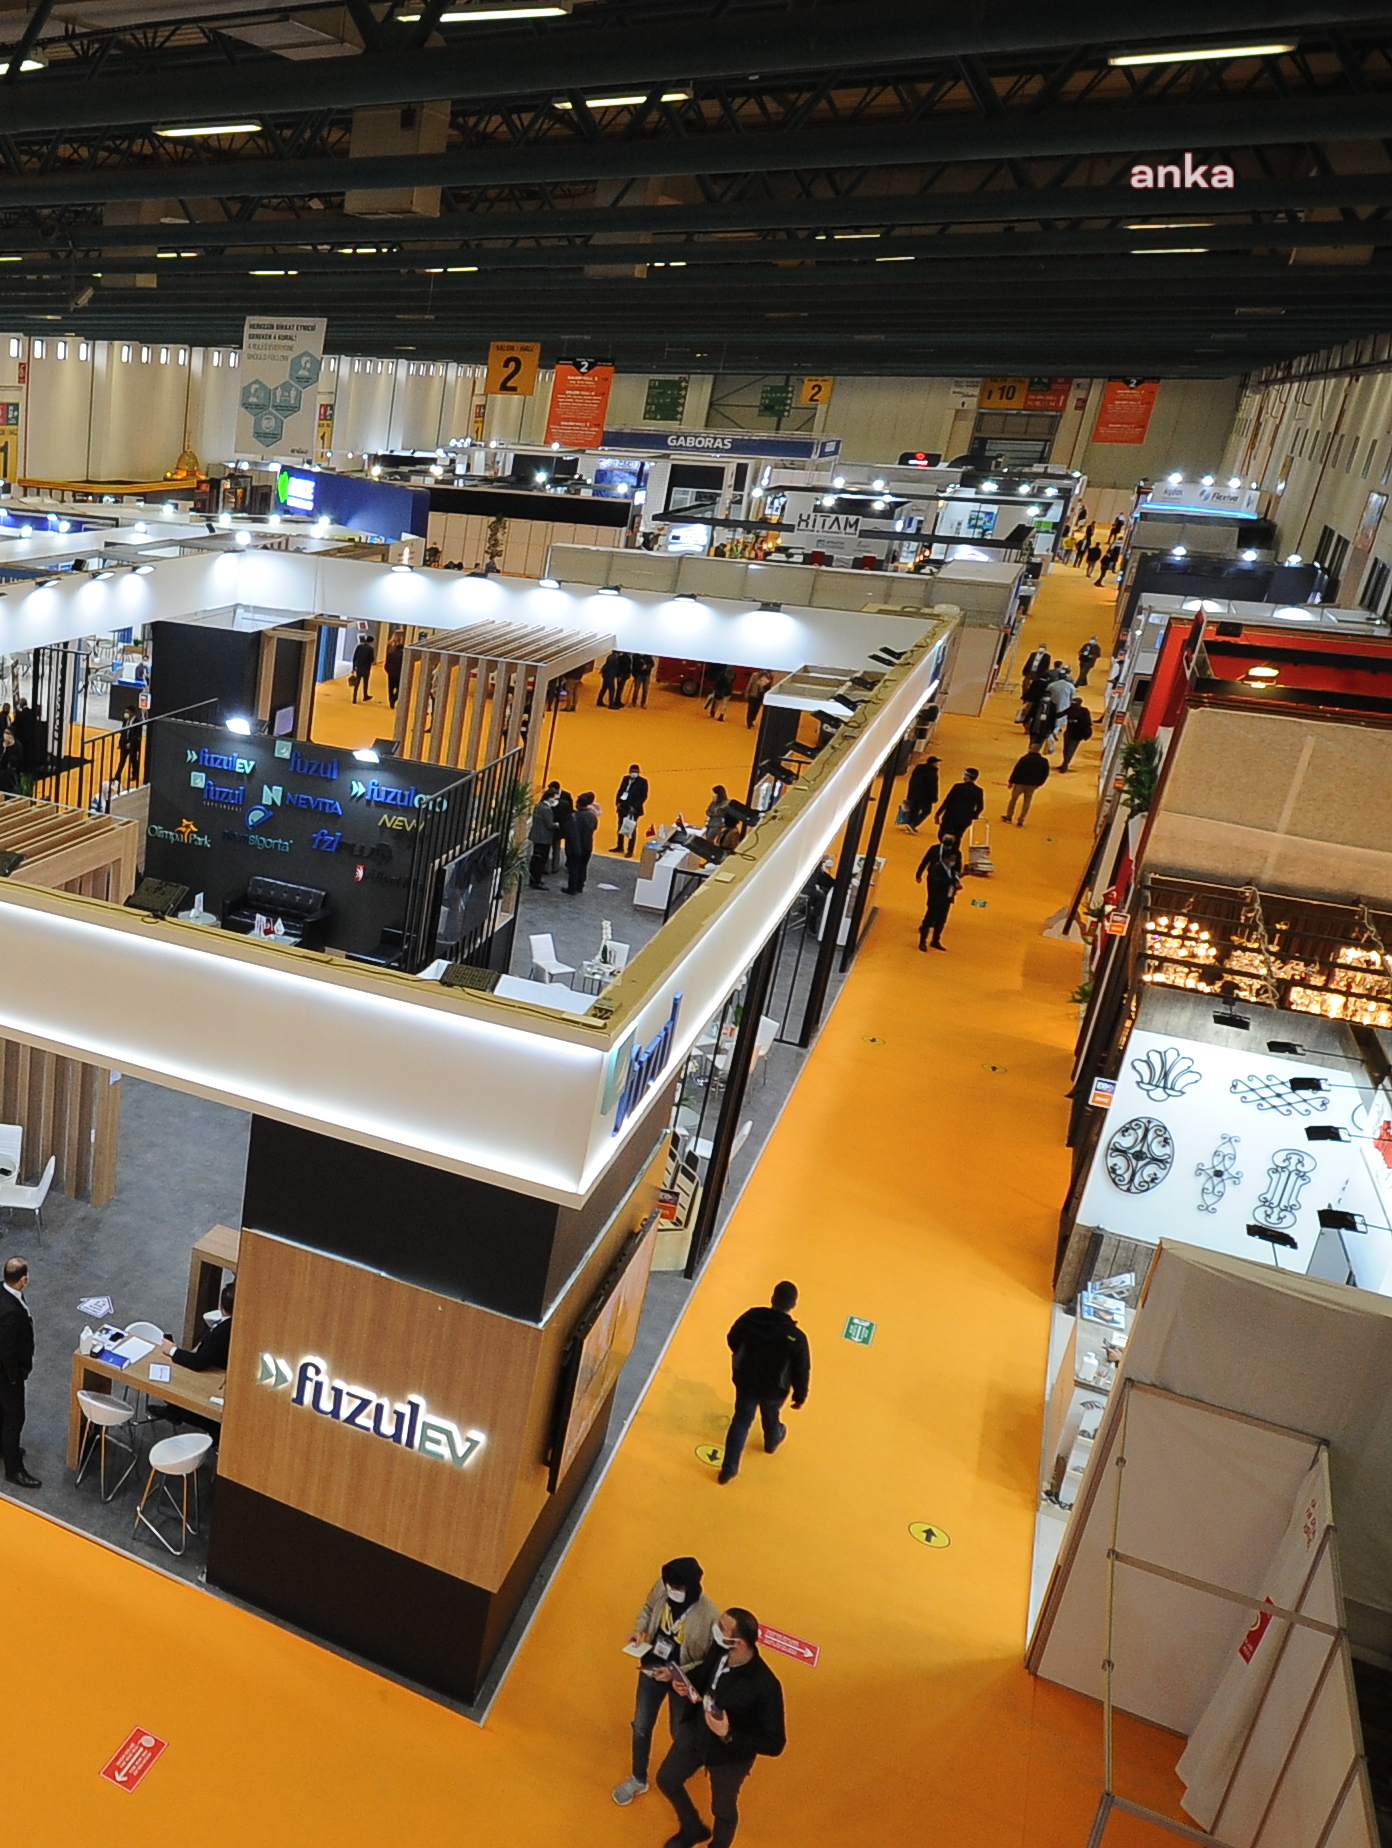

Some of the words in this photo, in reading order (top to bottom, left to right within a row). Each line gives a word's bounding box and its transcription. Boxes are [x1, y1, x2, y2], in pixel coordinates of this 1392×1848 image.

[499, 356, 523, 392] 2
[580, 361, 589, 373] 2
[808, 384, 822, 402] 2
[998, 385, 1017, 401] 10
[667, 435, 733, 450] GABORAS
[0, 441, 9, 478] 1
[290, 1360, 482, 1468] fuzulEV
